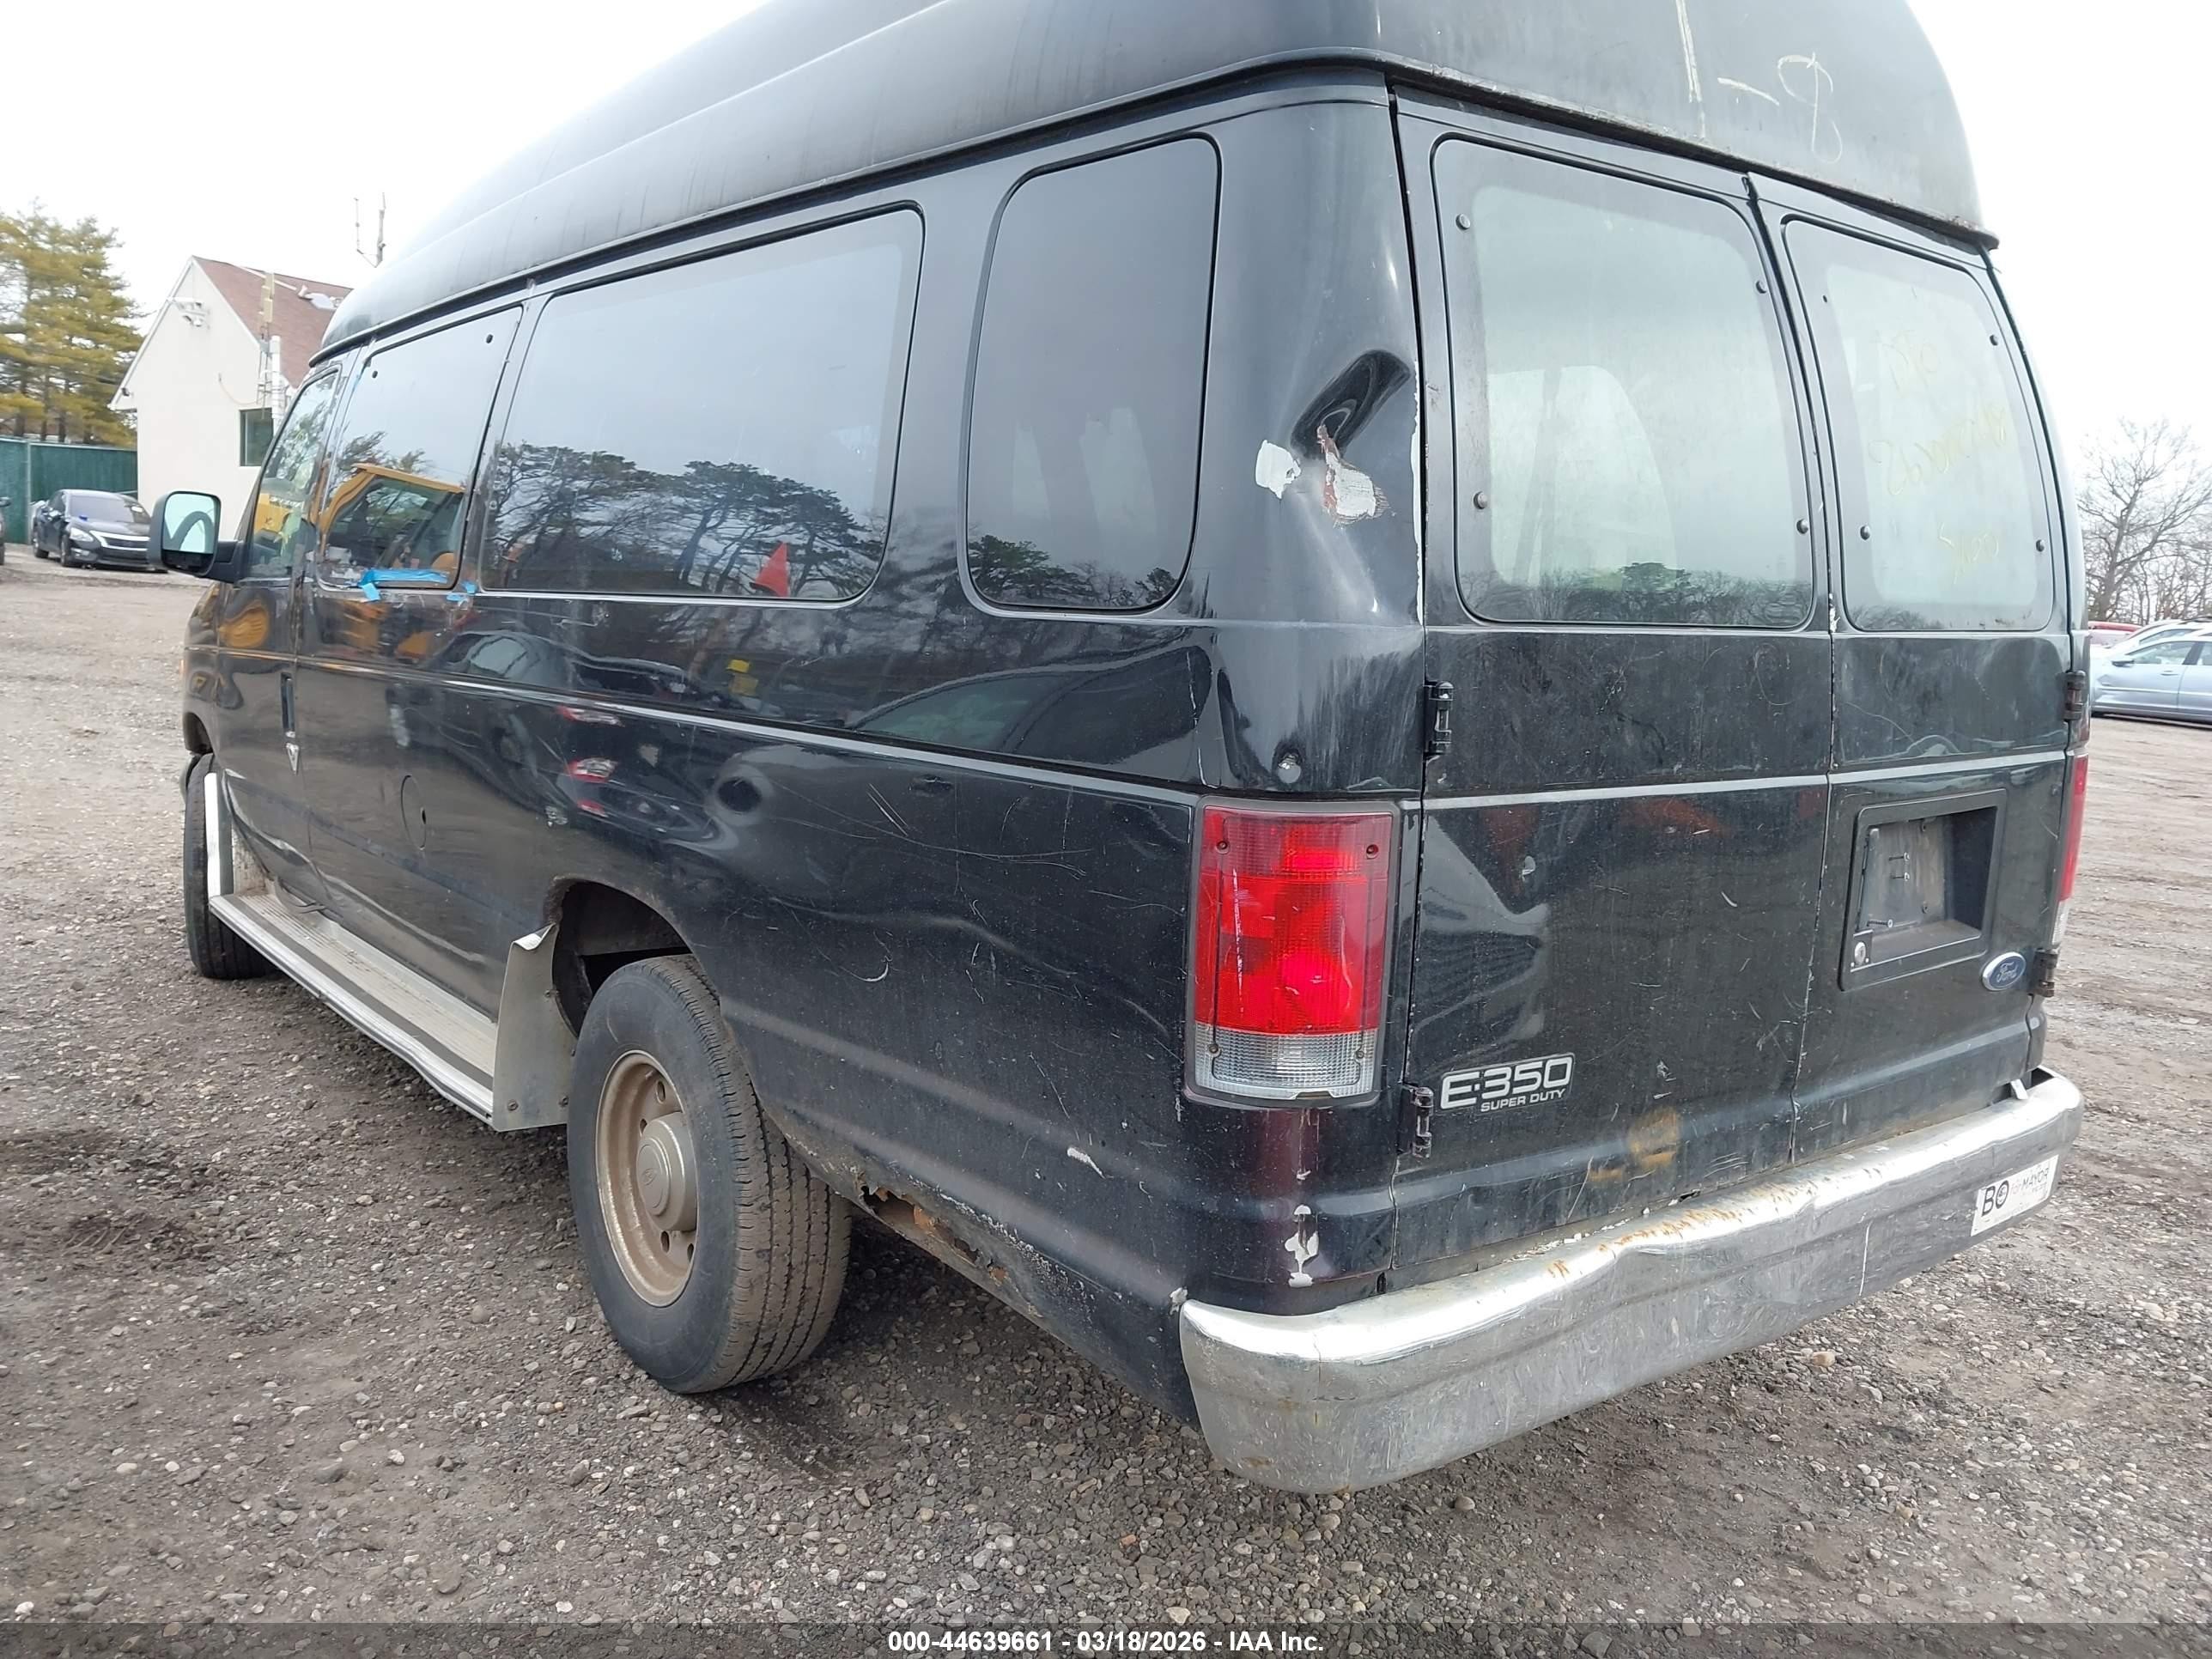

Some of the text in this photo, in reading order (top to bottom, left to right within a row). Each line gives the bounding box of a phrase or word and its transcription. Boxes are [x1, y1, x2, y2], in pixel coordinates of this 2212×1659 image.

[1440, 1056, 1573, 1109] E-350
[1480, 1088, 1566, 1112] SUPER DUTY
